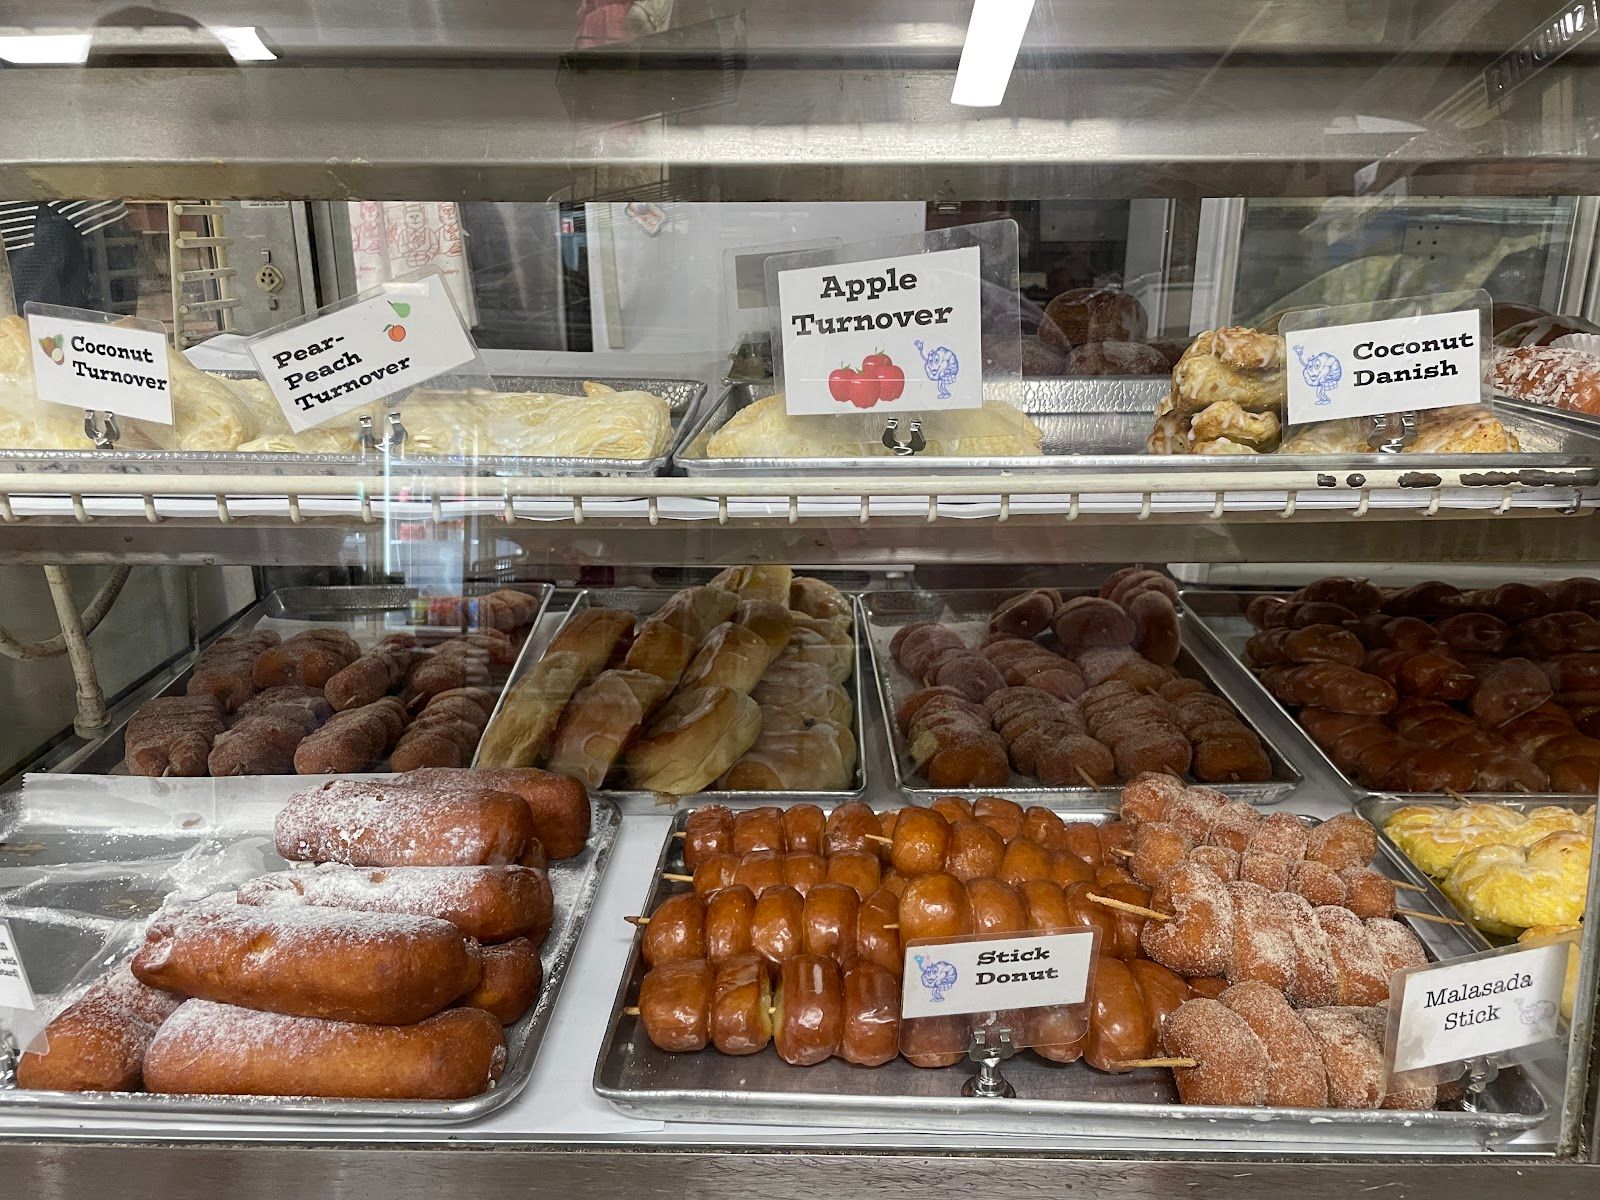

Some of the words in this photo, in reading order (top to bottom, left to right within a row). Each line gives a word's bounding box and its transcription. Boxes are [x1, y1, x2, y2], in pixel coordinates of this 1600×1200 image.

[820, 268, 917, 302] Apple
[791, 306, 953, 336] Turnover
[71, 336, 153, 363] Coconut
[272, 335, 345, 369] Pear-
[1352, 332, 1474, 360] Coconut
[73, 360, 167, 390] Turnover
[283, 352, 363, 390] Peach
[294, 357, 410, 411] Turnover
[1353, 360, 1458, 387] Danish
[976, 946, 1050, 966] Stick
[975, 967, 1058, 986] Donut
[1424, 973, 1533, 1008] Malasada
[1444, 1004, 1500, 1031] Stick
